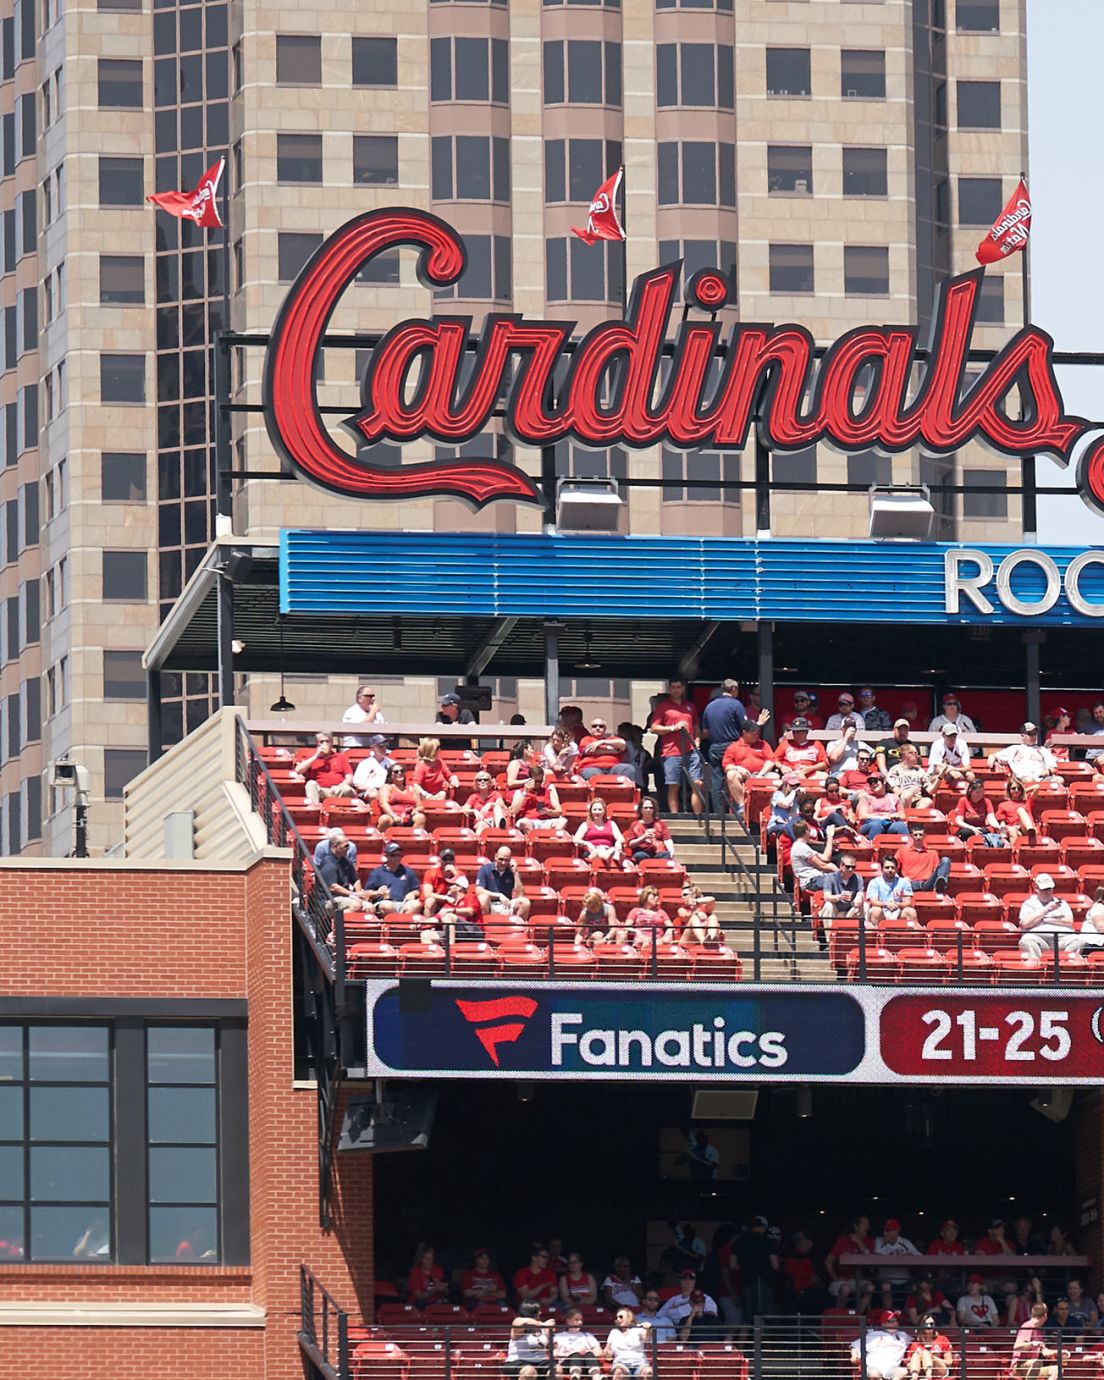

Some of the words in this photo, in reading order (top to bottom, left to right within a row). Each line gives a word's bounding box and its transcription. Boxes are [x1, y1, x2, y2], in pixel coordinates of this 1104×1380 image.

[266, 206, 1091, 511] Cardinals
[551, 1012, 788, 1068] Fanatics
[921, 1009, 1072, 1062] 21-25
